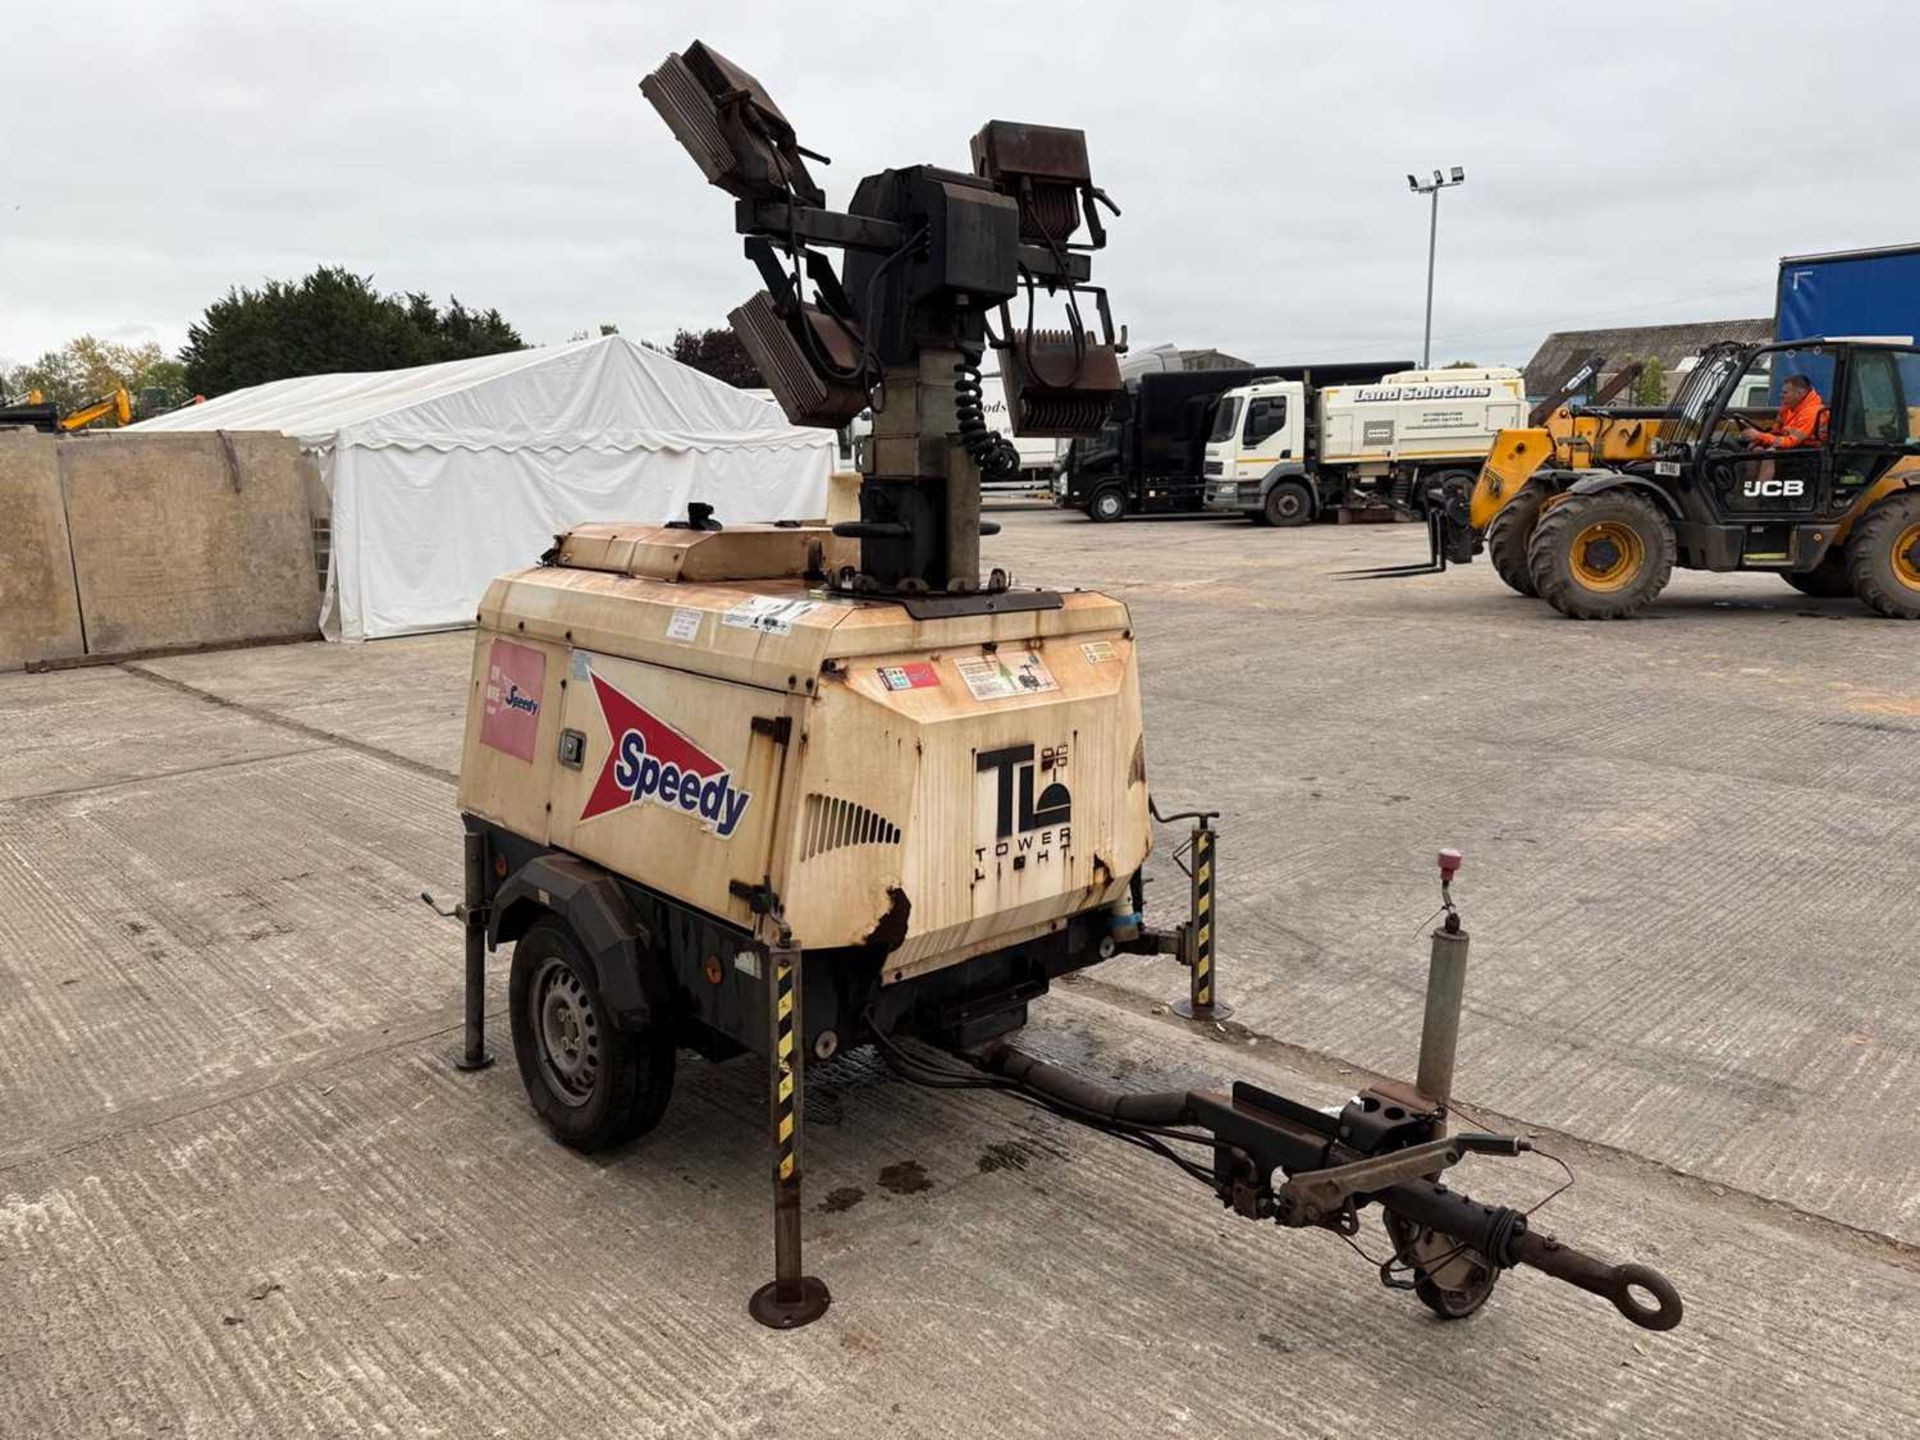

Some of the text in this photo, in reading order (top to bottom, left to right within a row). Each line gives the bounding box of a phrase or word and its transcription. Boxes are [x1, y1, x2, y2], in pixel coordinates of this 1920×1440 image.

[983, 400, 1006, 413] ods
[1354, 385, 1491, 402] Land Solutions
[1743, 480, 1805, 497] JCB
[505, 685, 538, 716] Speedy
[615, 731, 750, 836] Speedy
[975, 827, 1071, 863] TOWER
[974, 843, 1071, 882] LIGHT
